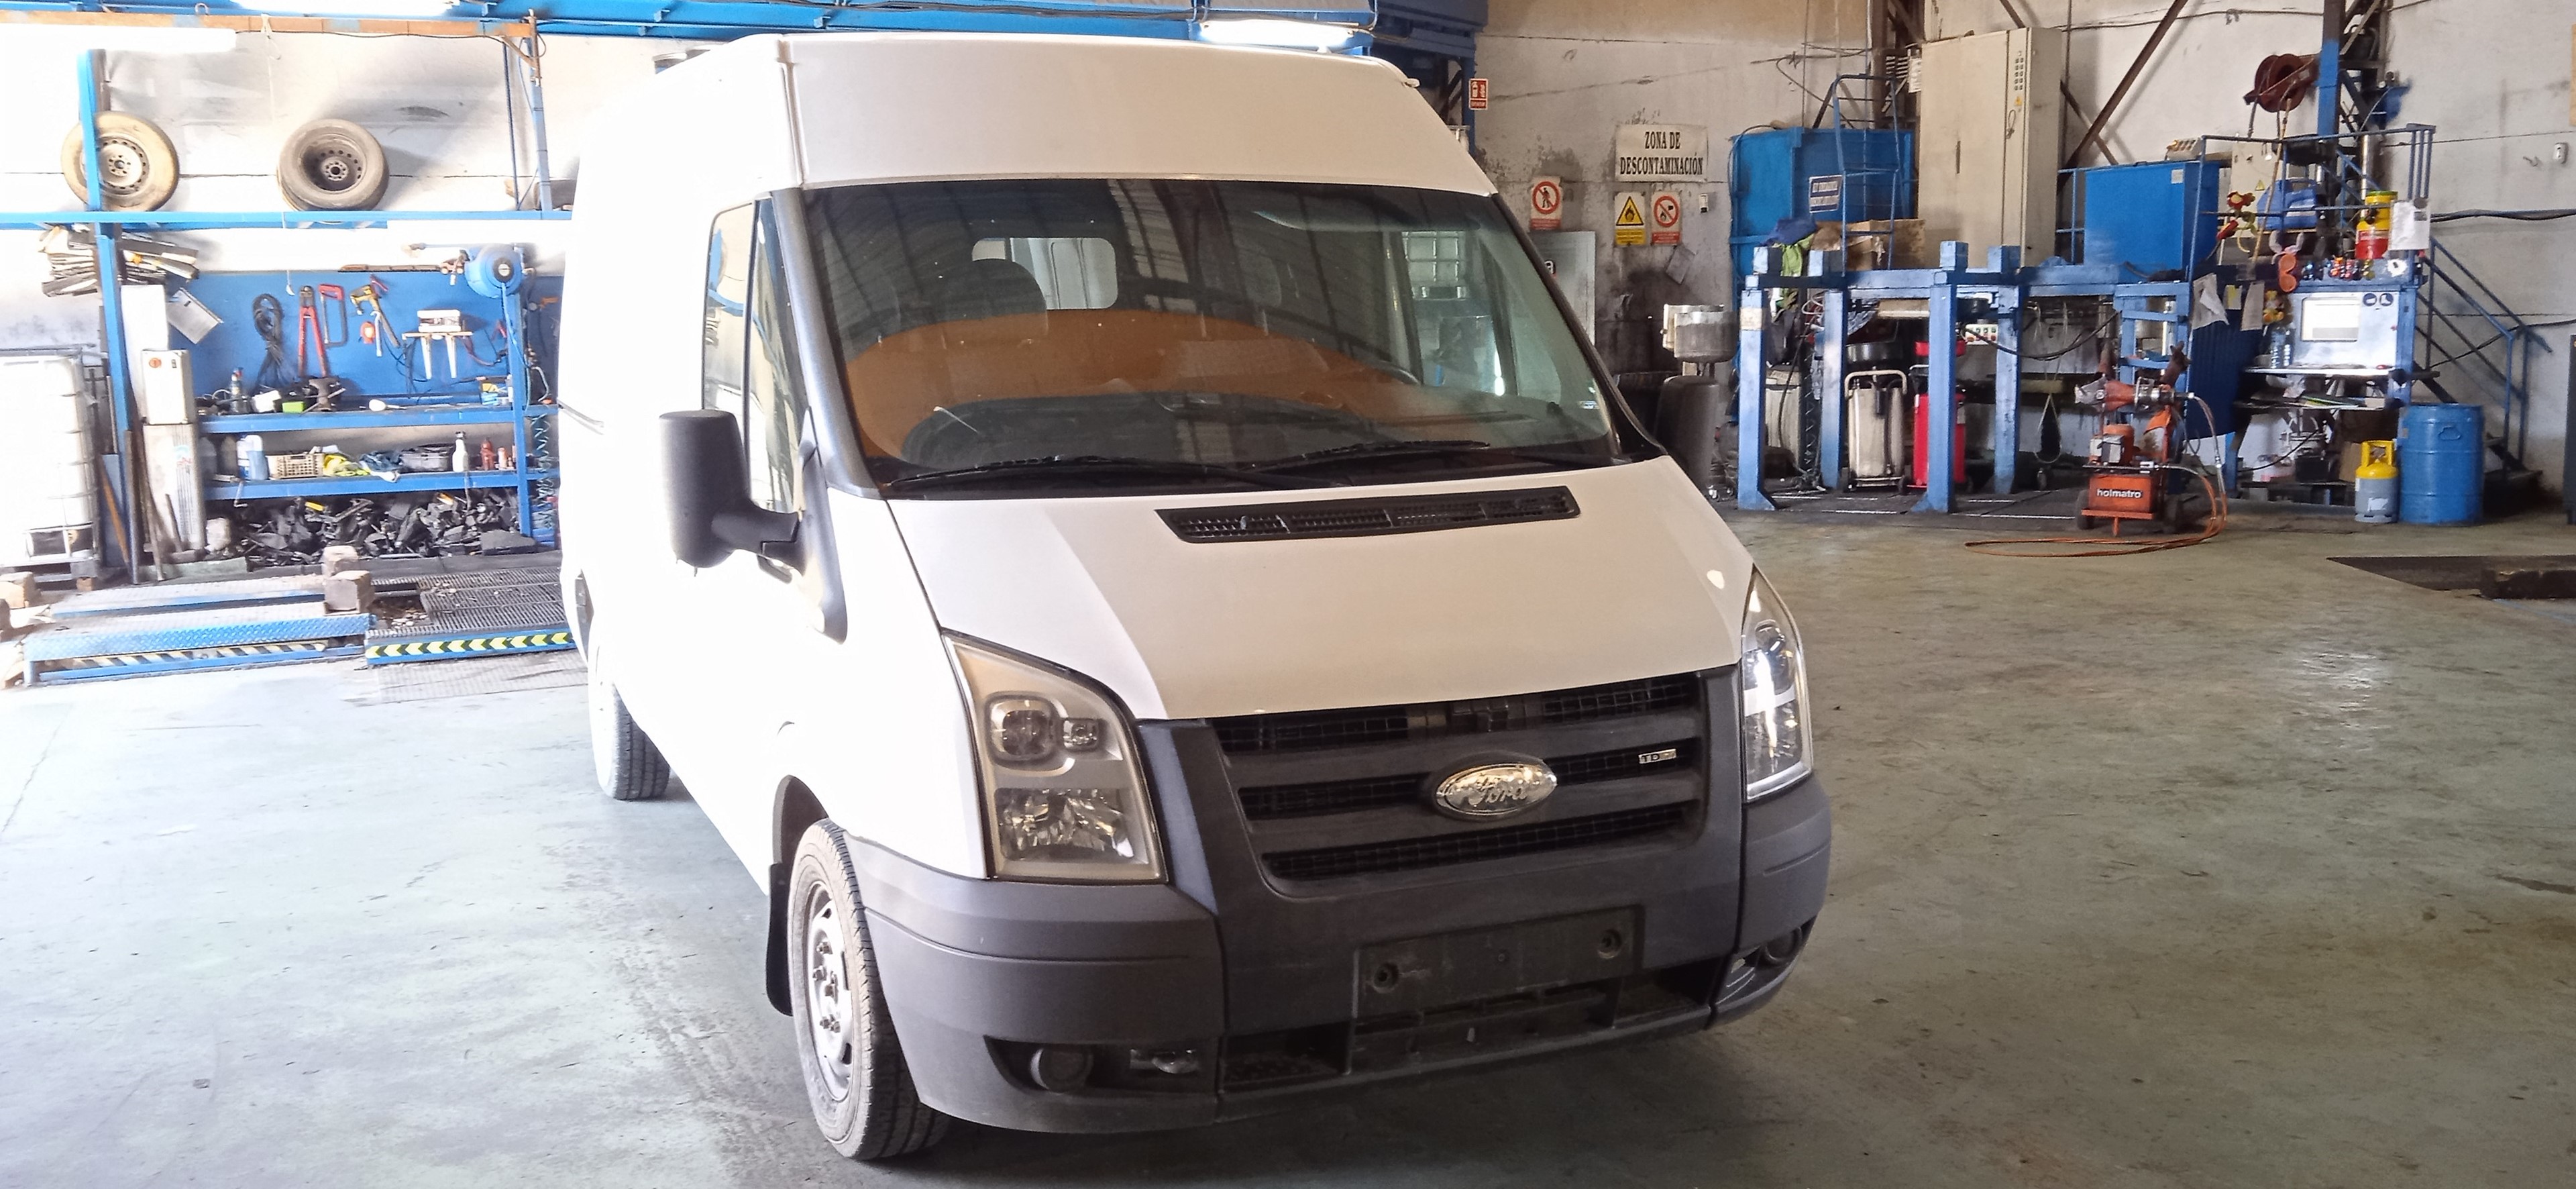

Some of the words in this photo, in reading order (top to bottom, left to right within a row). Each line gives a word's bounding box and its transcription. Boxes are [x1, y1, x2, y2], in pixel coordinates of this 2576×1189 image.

[1644, 131, 1666, 149] ZONA
[1669, 132, 1680, 149] DE
[1619, 152, 1703, 174] DESCONTAMINACIÓN
[2096, 488, 2142, 499] holmatro
[1640, 749, 1676, 763] TD
[1451, 770, 1536, 808] Ford
